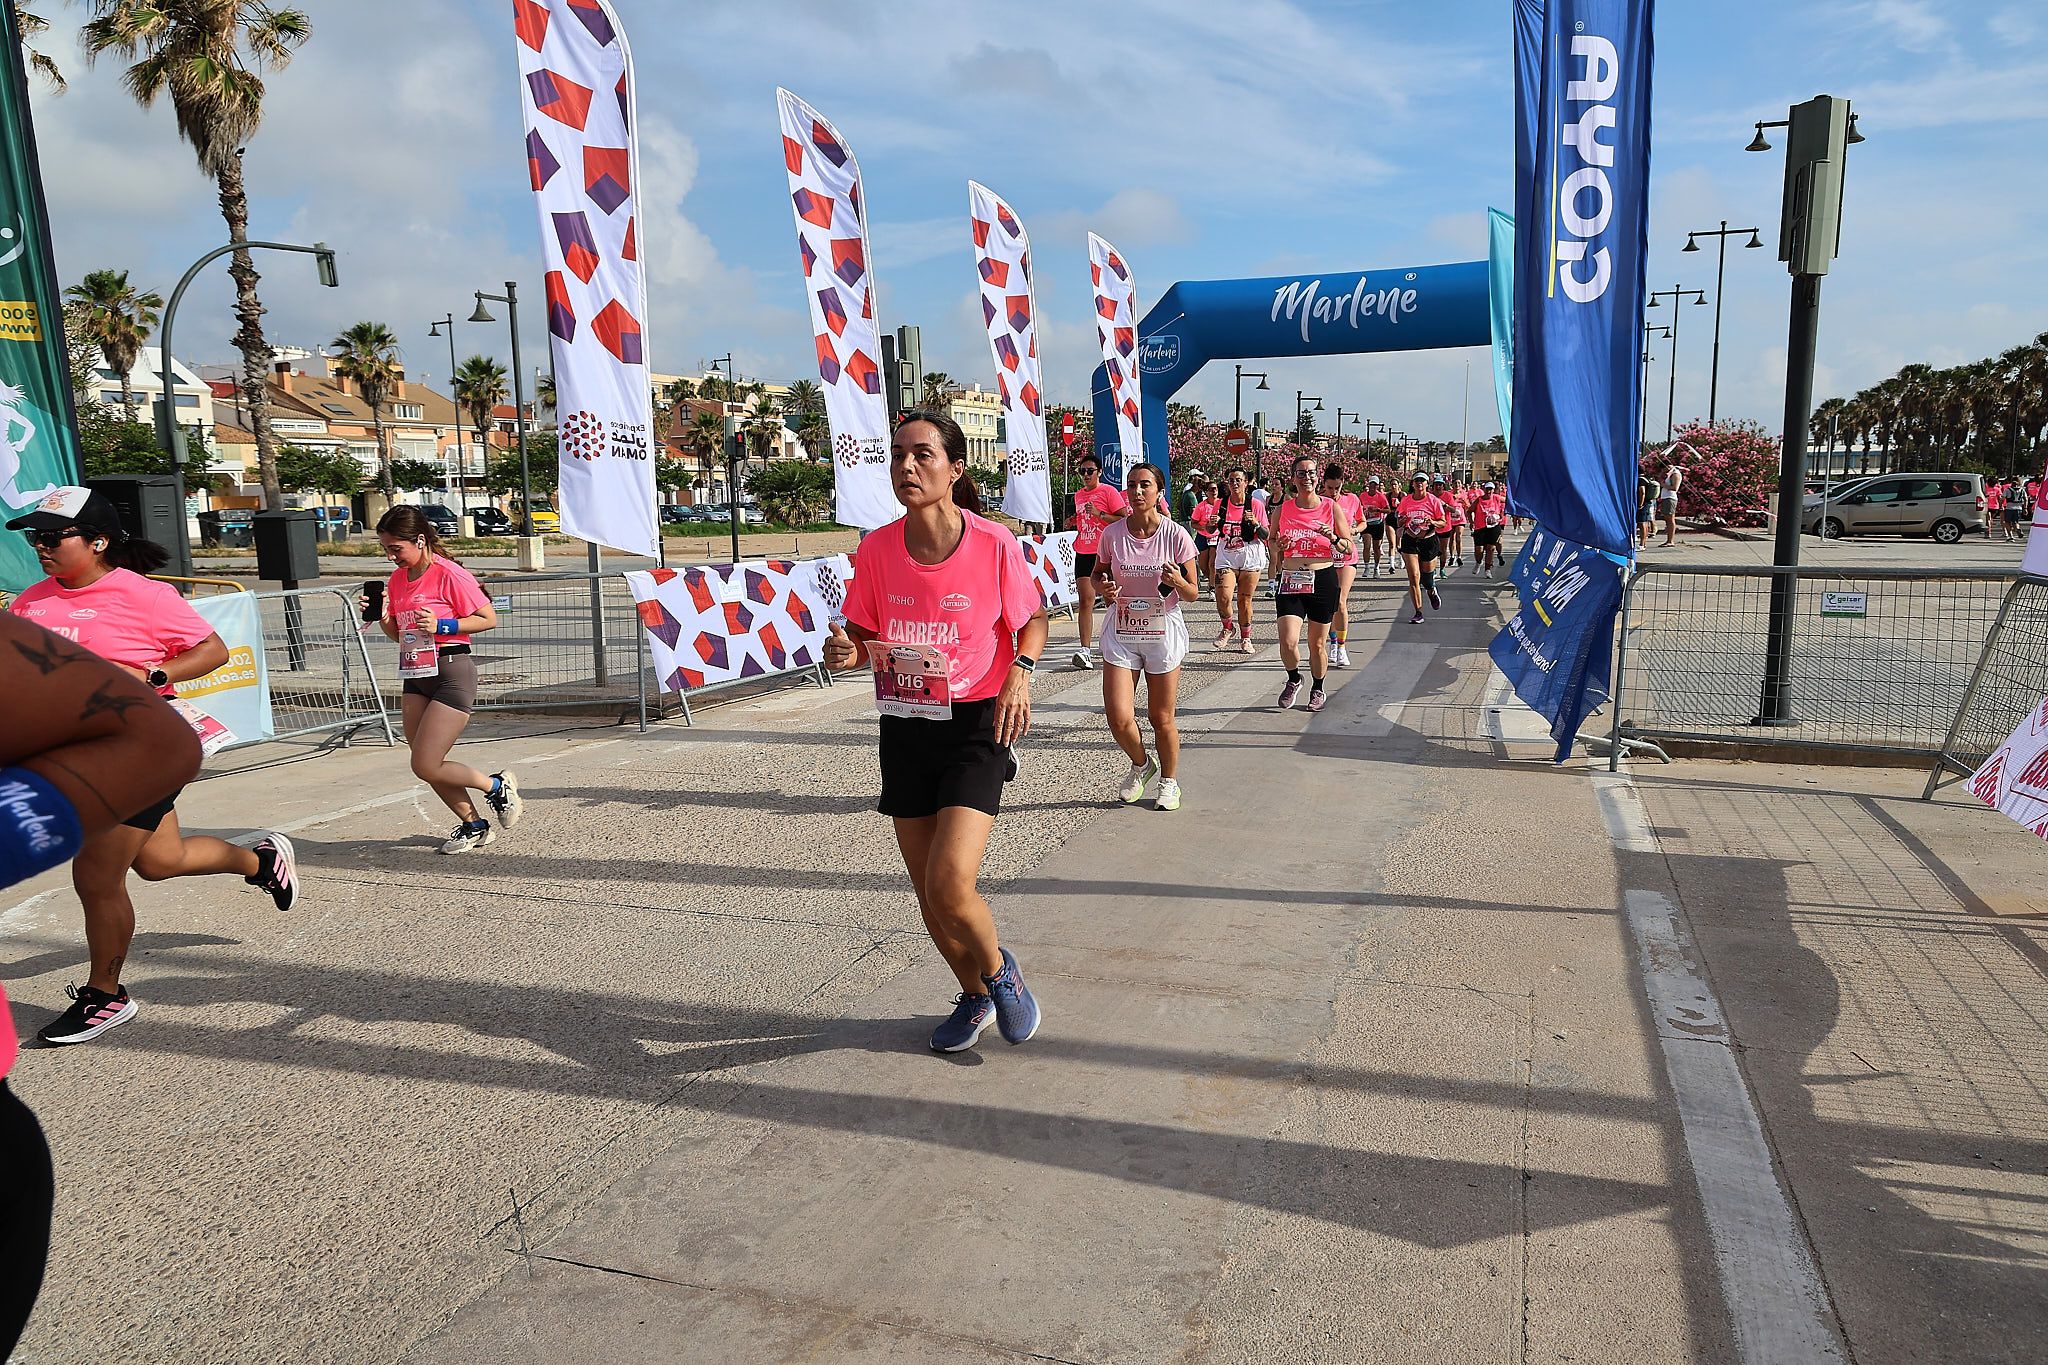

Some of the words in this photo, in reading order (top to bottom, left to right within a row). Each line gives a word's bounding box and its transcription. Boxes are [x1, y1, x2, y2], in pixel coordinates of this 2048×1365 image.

[1271, 276, 1417, 343] Marlene
[1139, 344, 1177, 364] Marlene
[886, 618, 961, 645] CARRERA
[1130, 618, 1150, 626] 016
[896, 674, 924, 688] 016
